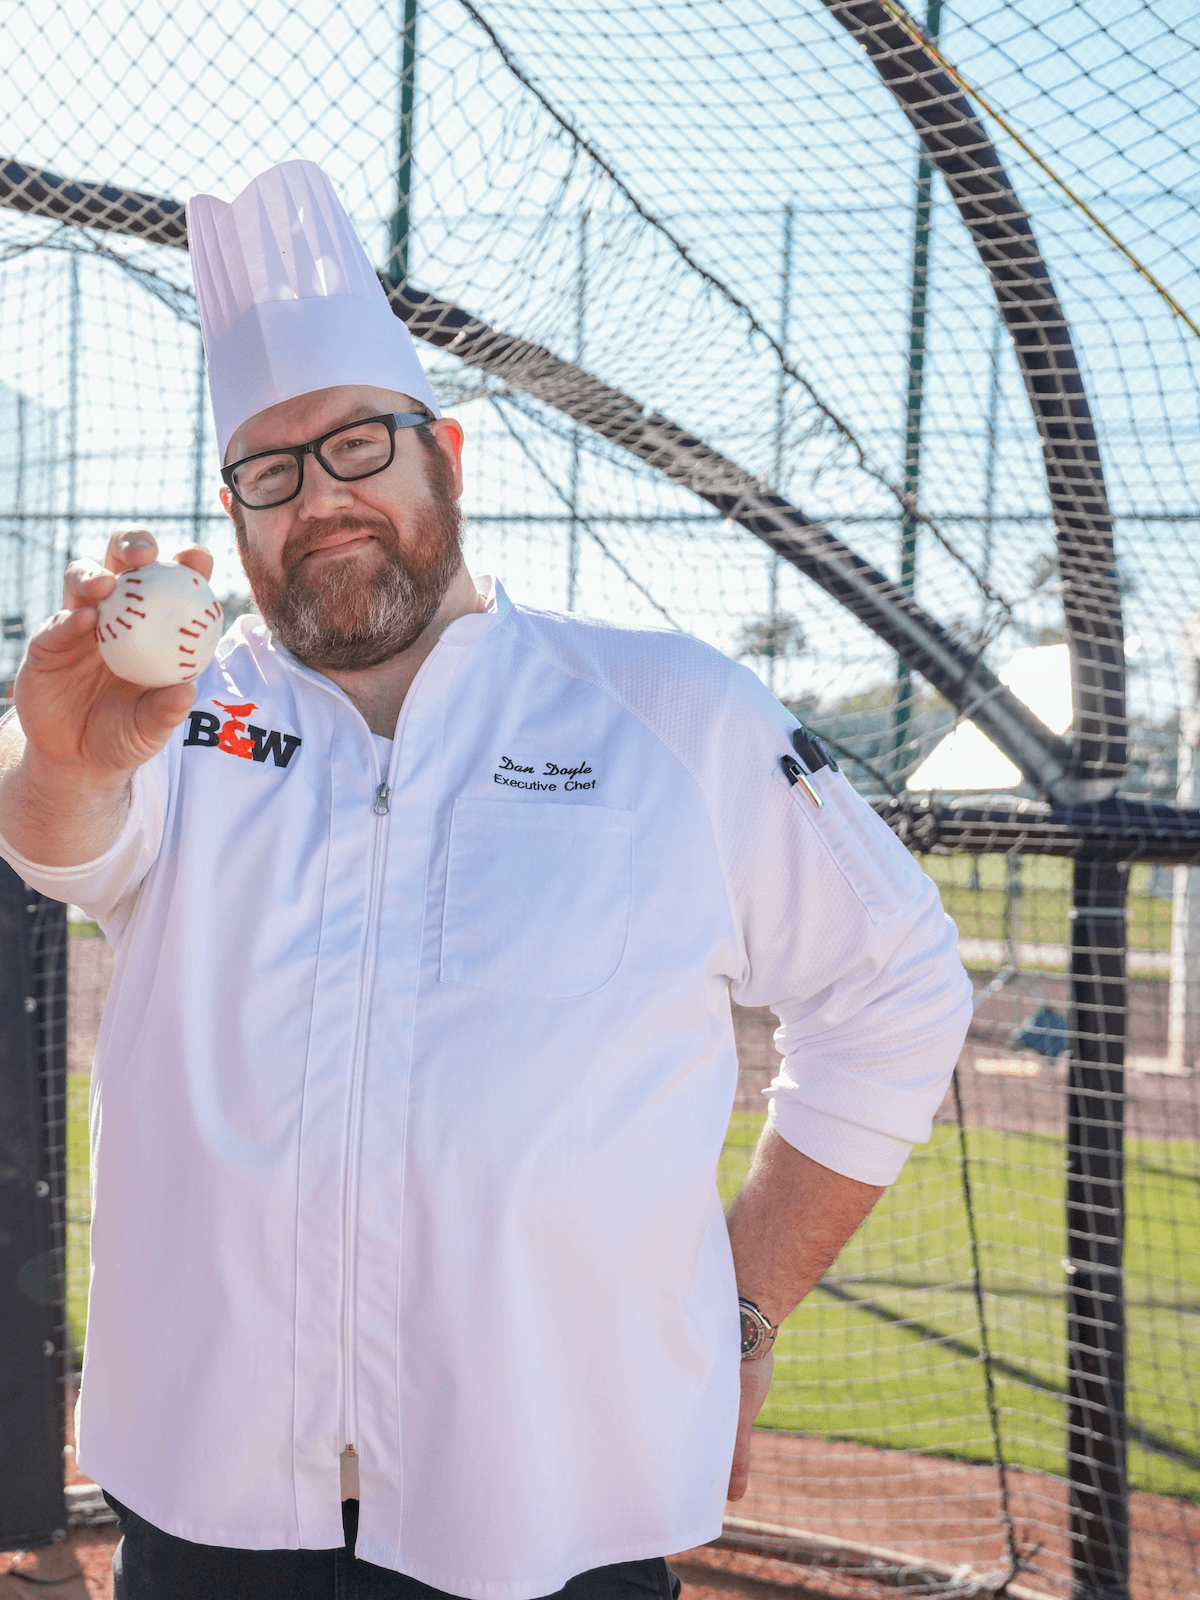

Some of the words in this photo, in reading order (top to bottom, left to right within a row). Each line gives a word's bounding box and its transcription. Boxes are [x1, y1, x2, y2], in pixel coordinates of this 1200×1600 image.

[183, 711, 302, 768] B&W
[498, 756, 535, 774] Dan
[542, 761, 593, 780] Doyle
[493, 773, 557, 792] Executive
[564, 779, 597, 792] Chef
